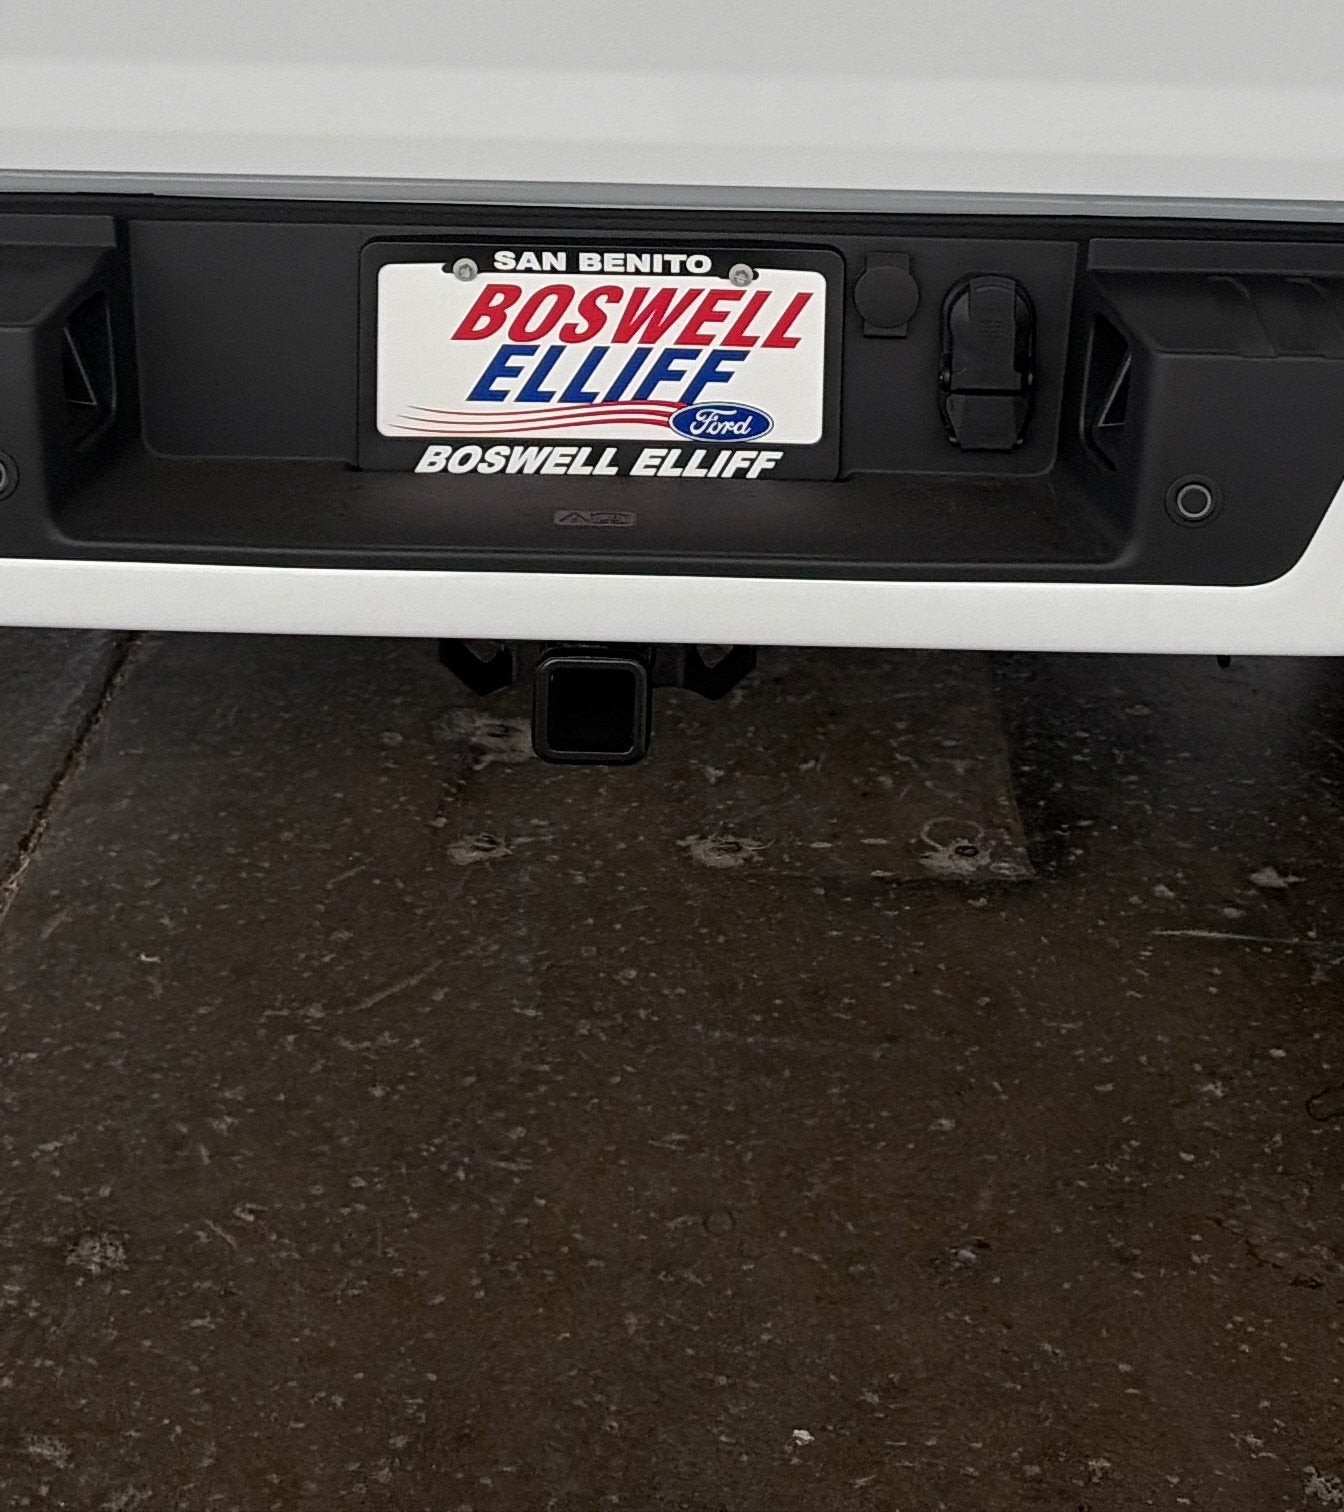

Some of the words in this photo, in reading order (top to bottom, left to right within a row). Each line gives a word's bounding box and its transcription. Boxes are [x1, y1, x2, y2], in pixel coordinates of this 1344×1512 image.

[493, 251, 567, 272] SAN
[578, 252, 712, 274] BENITO
[451, 283, 814, 348] BOSWELL
[466, 344, 751, 404] ELLIFF
[689, 408, 753, 437] Ford
[414, 445, 619, 476] BOSWELL
[629, 449, 784, 479] ELLIFF
